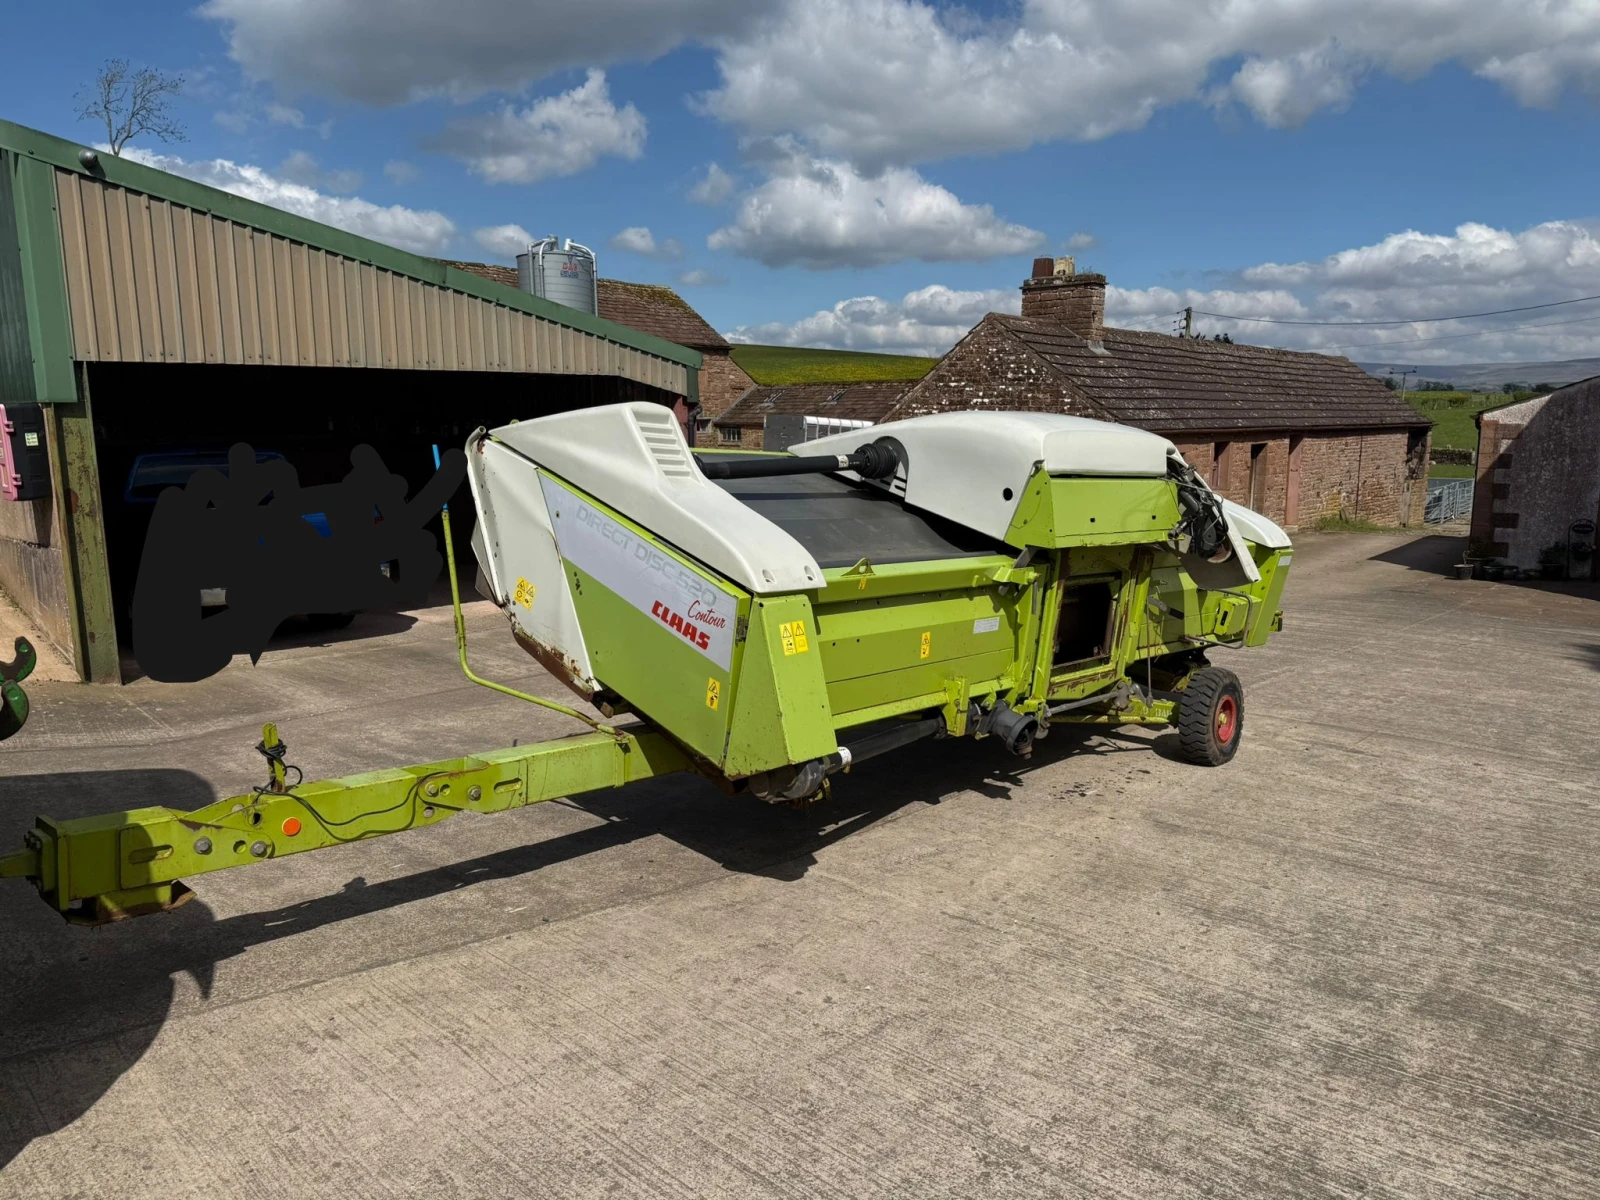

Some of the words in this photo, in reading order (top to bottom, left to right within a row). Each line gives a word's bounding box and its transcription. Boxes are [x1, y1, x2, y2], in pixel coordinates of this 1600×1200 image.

[576, 504, 633, 550] DIRECT
[634, 543, 675, 580] DISC
[676, 570, 717, 607] 520
[651, 599, 711, 651] CLAAS
[687, 599, 726, 629] Contour
